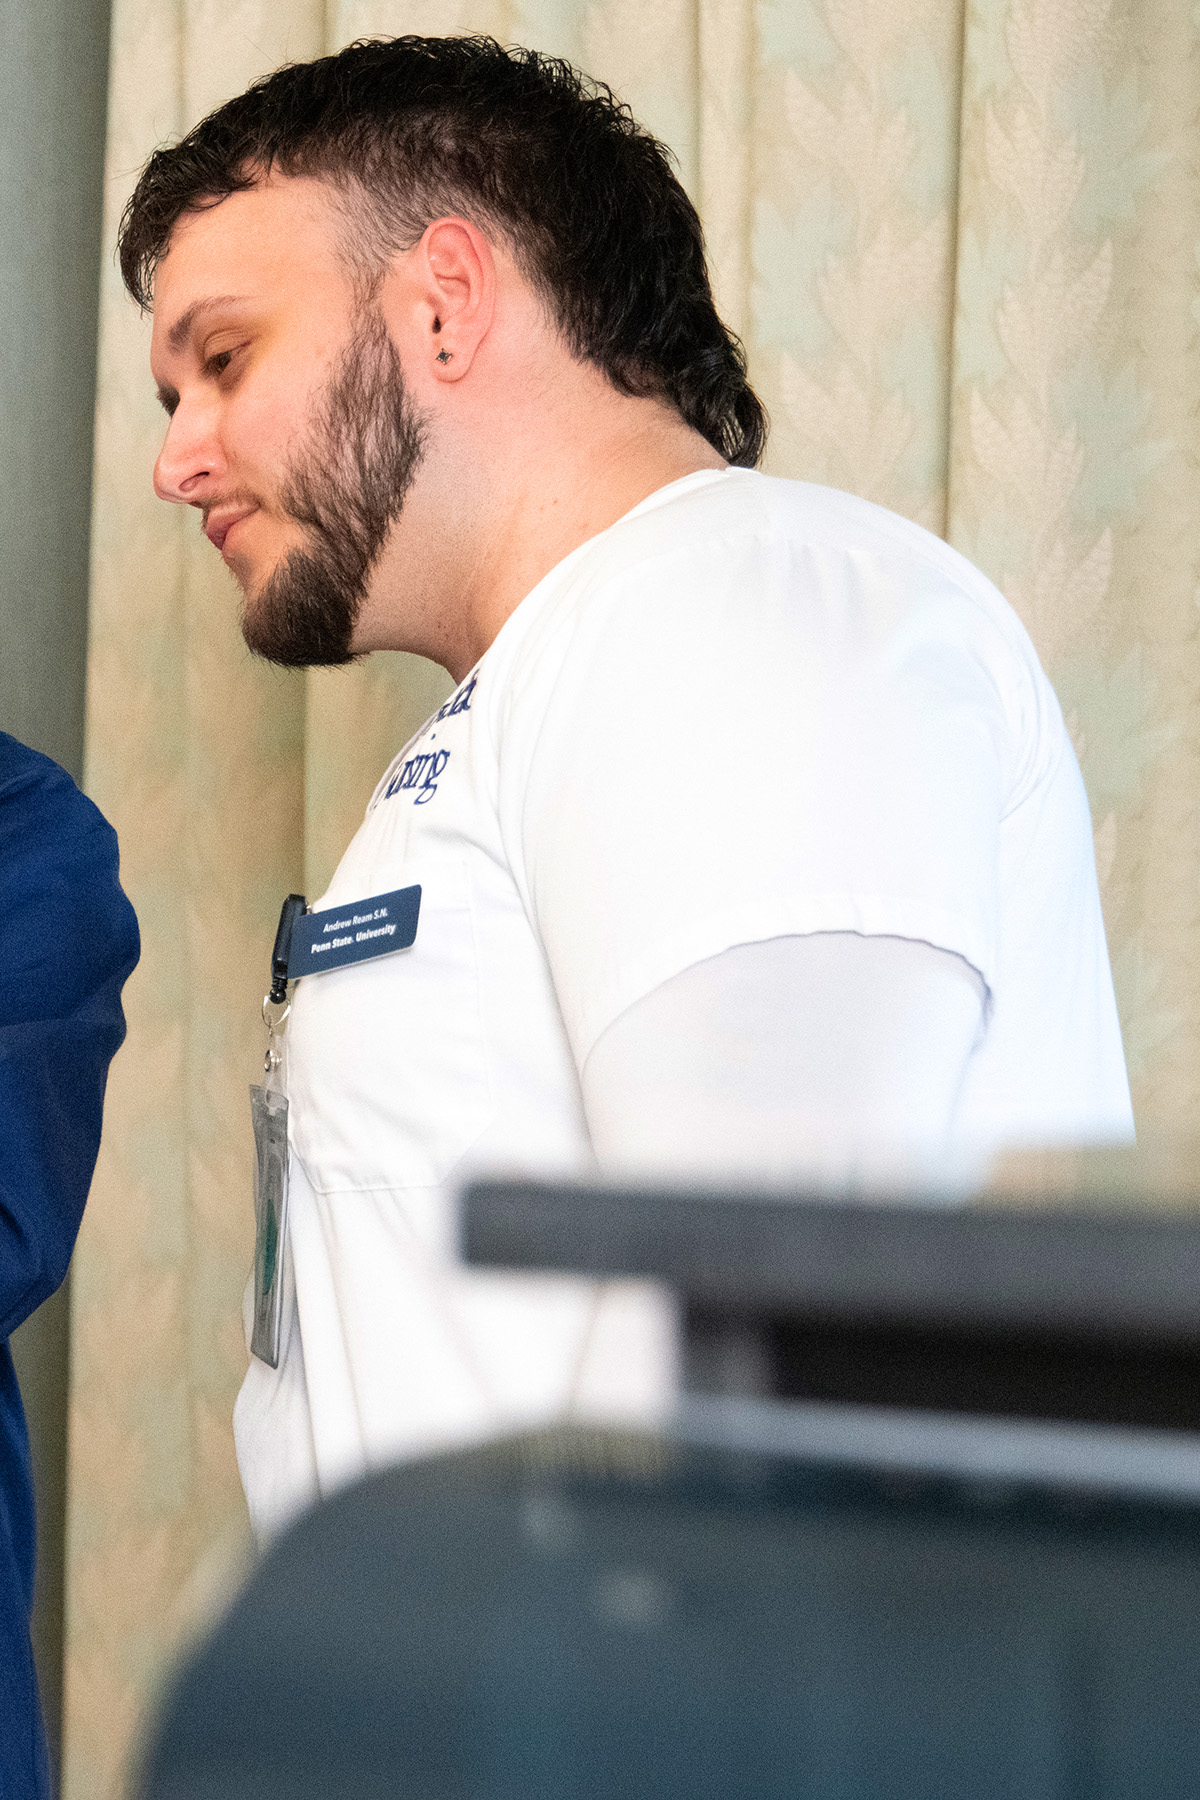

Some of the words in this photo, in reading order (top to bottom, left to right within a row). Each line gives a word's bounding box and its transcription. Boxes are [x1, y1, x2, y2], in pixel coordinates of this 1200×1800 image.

[322, 919, 352, 934] Andrew
[310, 941, 332, 954] Penn
[355, 923, 397, 943] University
